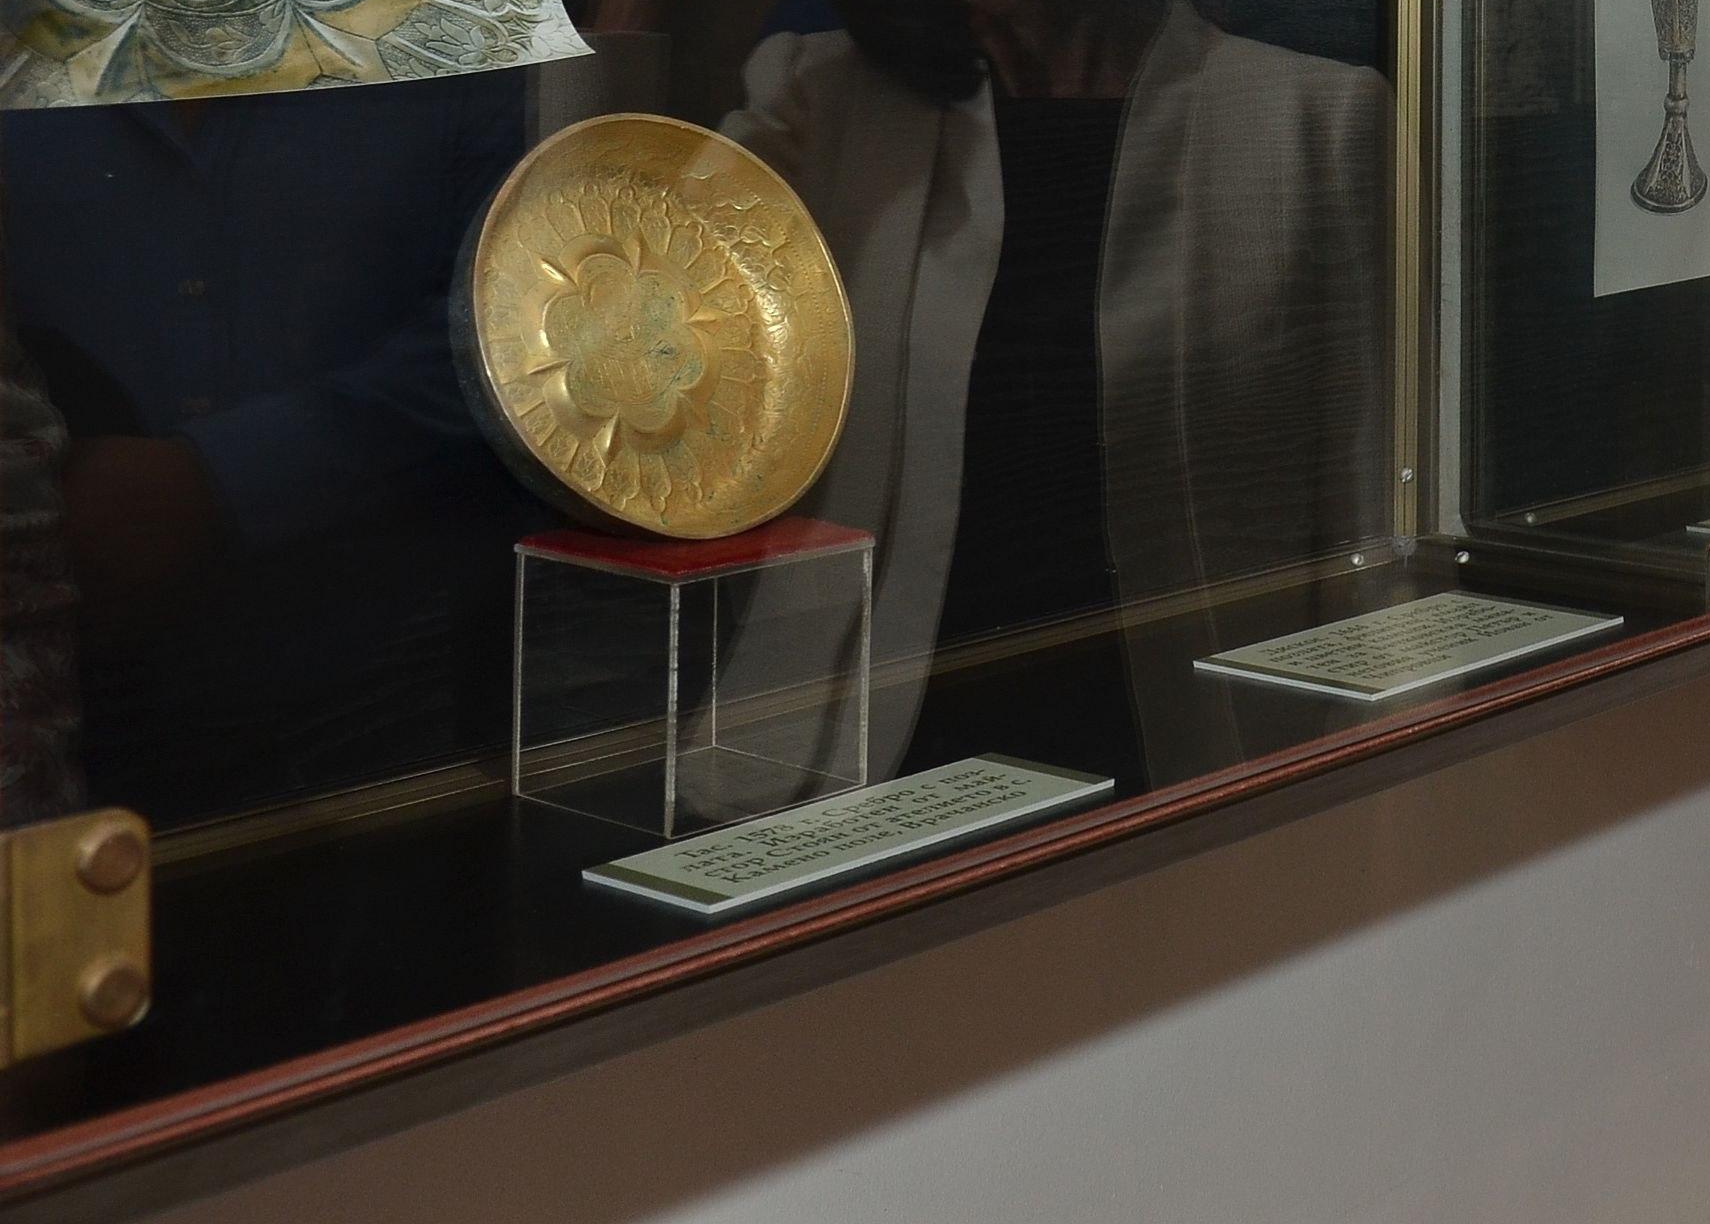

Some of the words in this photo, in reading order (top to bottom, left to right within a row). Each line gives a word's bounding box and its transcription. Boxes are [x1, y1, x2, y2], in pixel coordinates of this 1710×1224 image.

[675, 845, 733, 858] Тас.
[822, 790, 916, 816] Сребро
[939, 770, 984, 784] поз-
[682, 852, 752, 872] лата.
[758, 805, 902, 849] Изработен
[954, 774, 1006, 791] май-
[705, 858, 764, 877] стор
[766, 833, 850, 857] Стоян
[886, 791, 991, 822] ателието
[721, 851, 830, 883] Камено
[833, 831, 903, 851] поле,
[900, 791, 1026, 829] Врачанско
